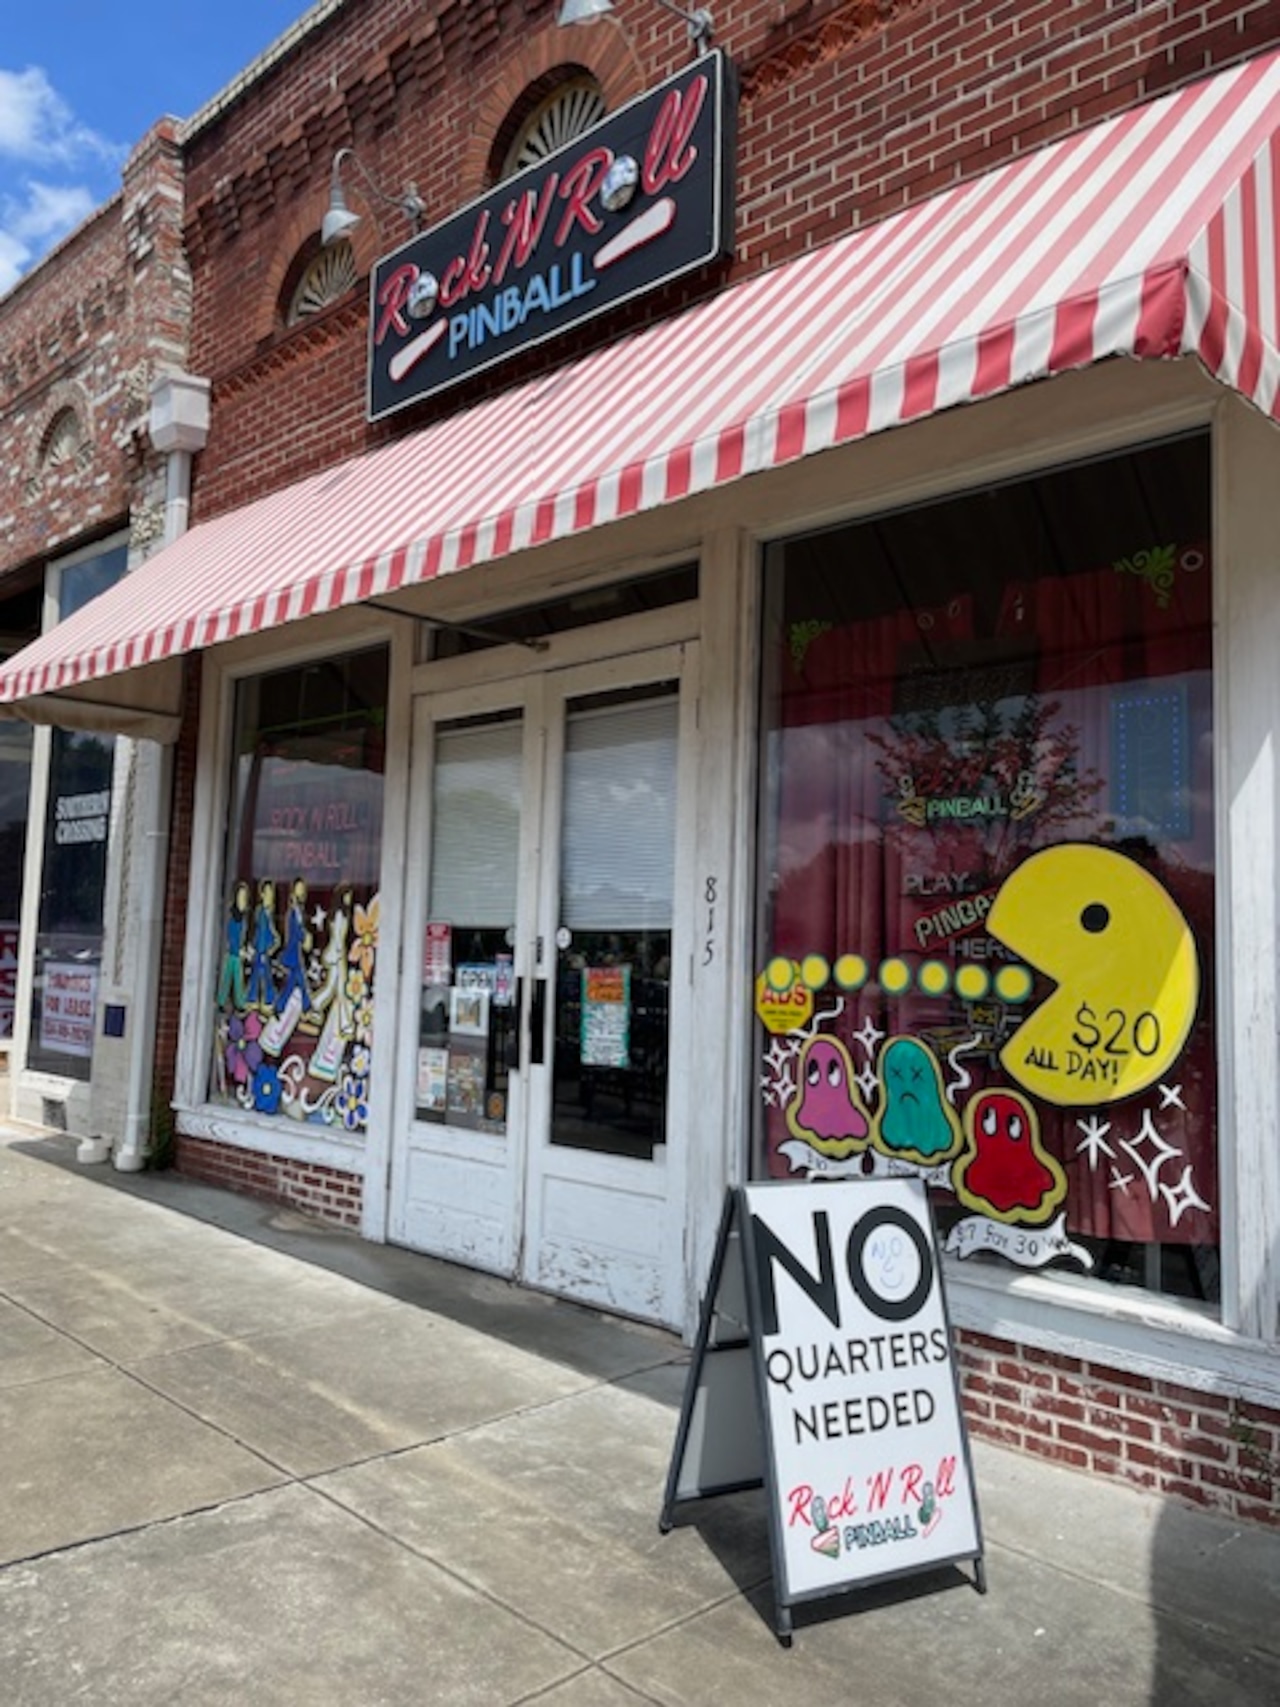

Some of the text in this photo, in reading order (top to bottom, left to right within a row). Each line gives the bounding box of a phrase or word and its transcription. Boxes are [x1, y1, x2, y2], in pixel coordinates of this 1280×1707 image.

[449, 252, 597, 359] PINBALL
[927, 797, 1007, 819] PINBALL
[903, 871, 970, 896] PLAY
[1071, 1000, 1161, 1057] $20
[1023, 1045, 1119, 1086] ALL DAY!
[1014, 1233, 1039, 1257] 30
[751, 1204, 934, 1336] NO
[766, 1328, 950, 1394] QUARTERS
[793, 1388, 936, 1446] NEEDED
[843, 1513, 918, 1552] PINBALL
